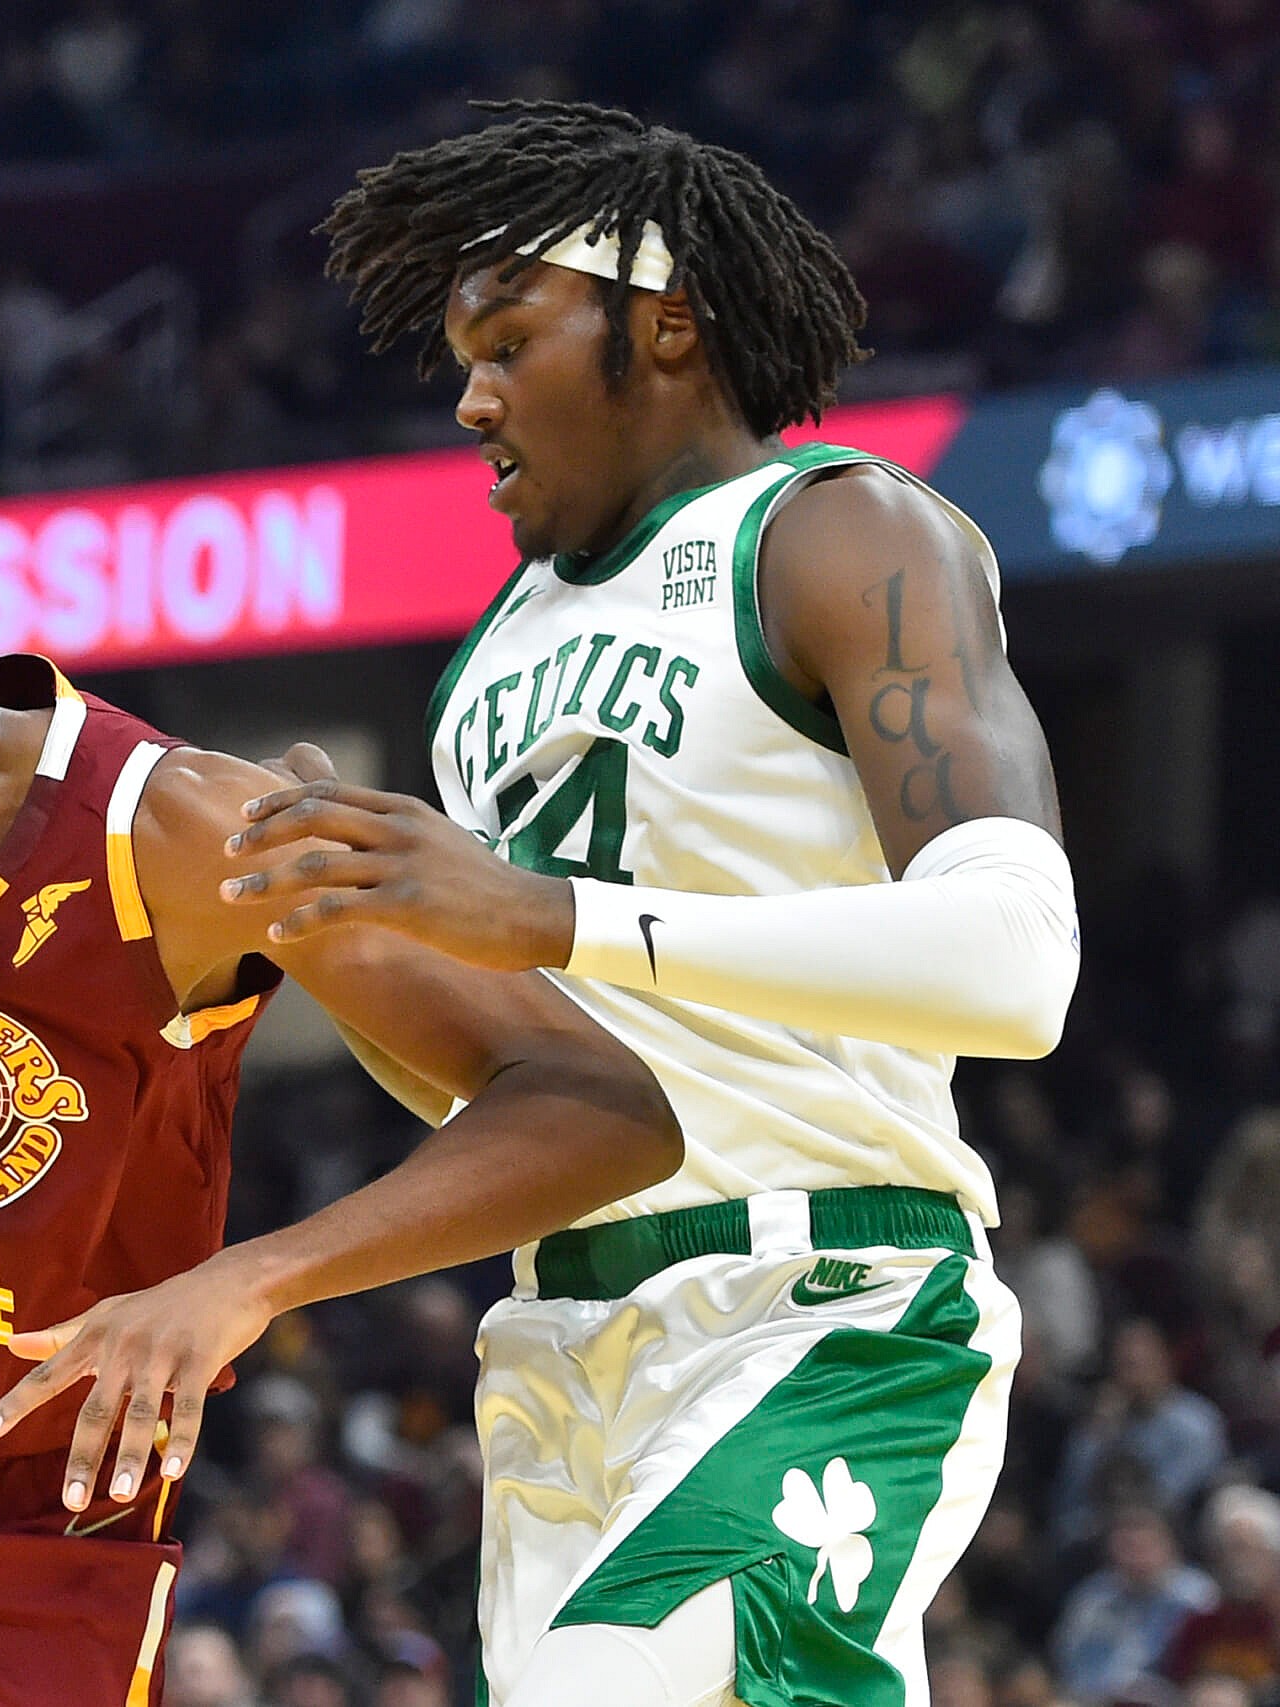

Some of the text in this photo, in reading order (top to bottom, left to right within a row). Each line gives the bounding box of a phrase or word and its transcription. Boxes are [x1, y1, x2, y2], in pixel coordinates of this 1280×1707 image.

[662, 539, 717, 580] VISTA
[661, 575, 717, 611] PRINT
[492, 736, 635, 886] 4
[807, 1256, 873, 1291] NIKE
